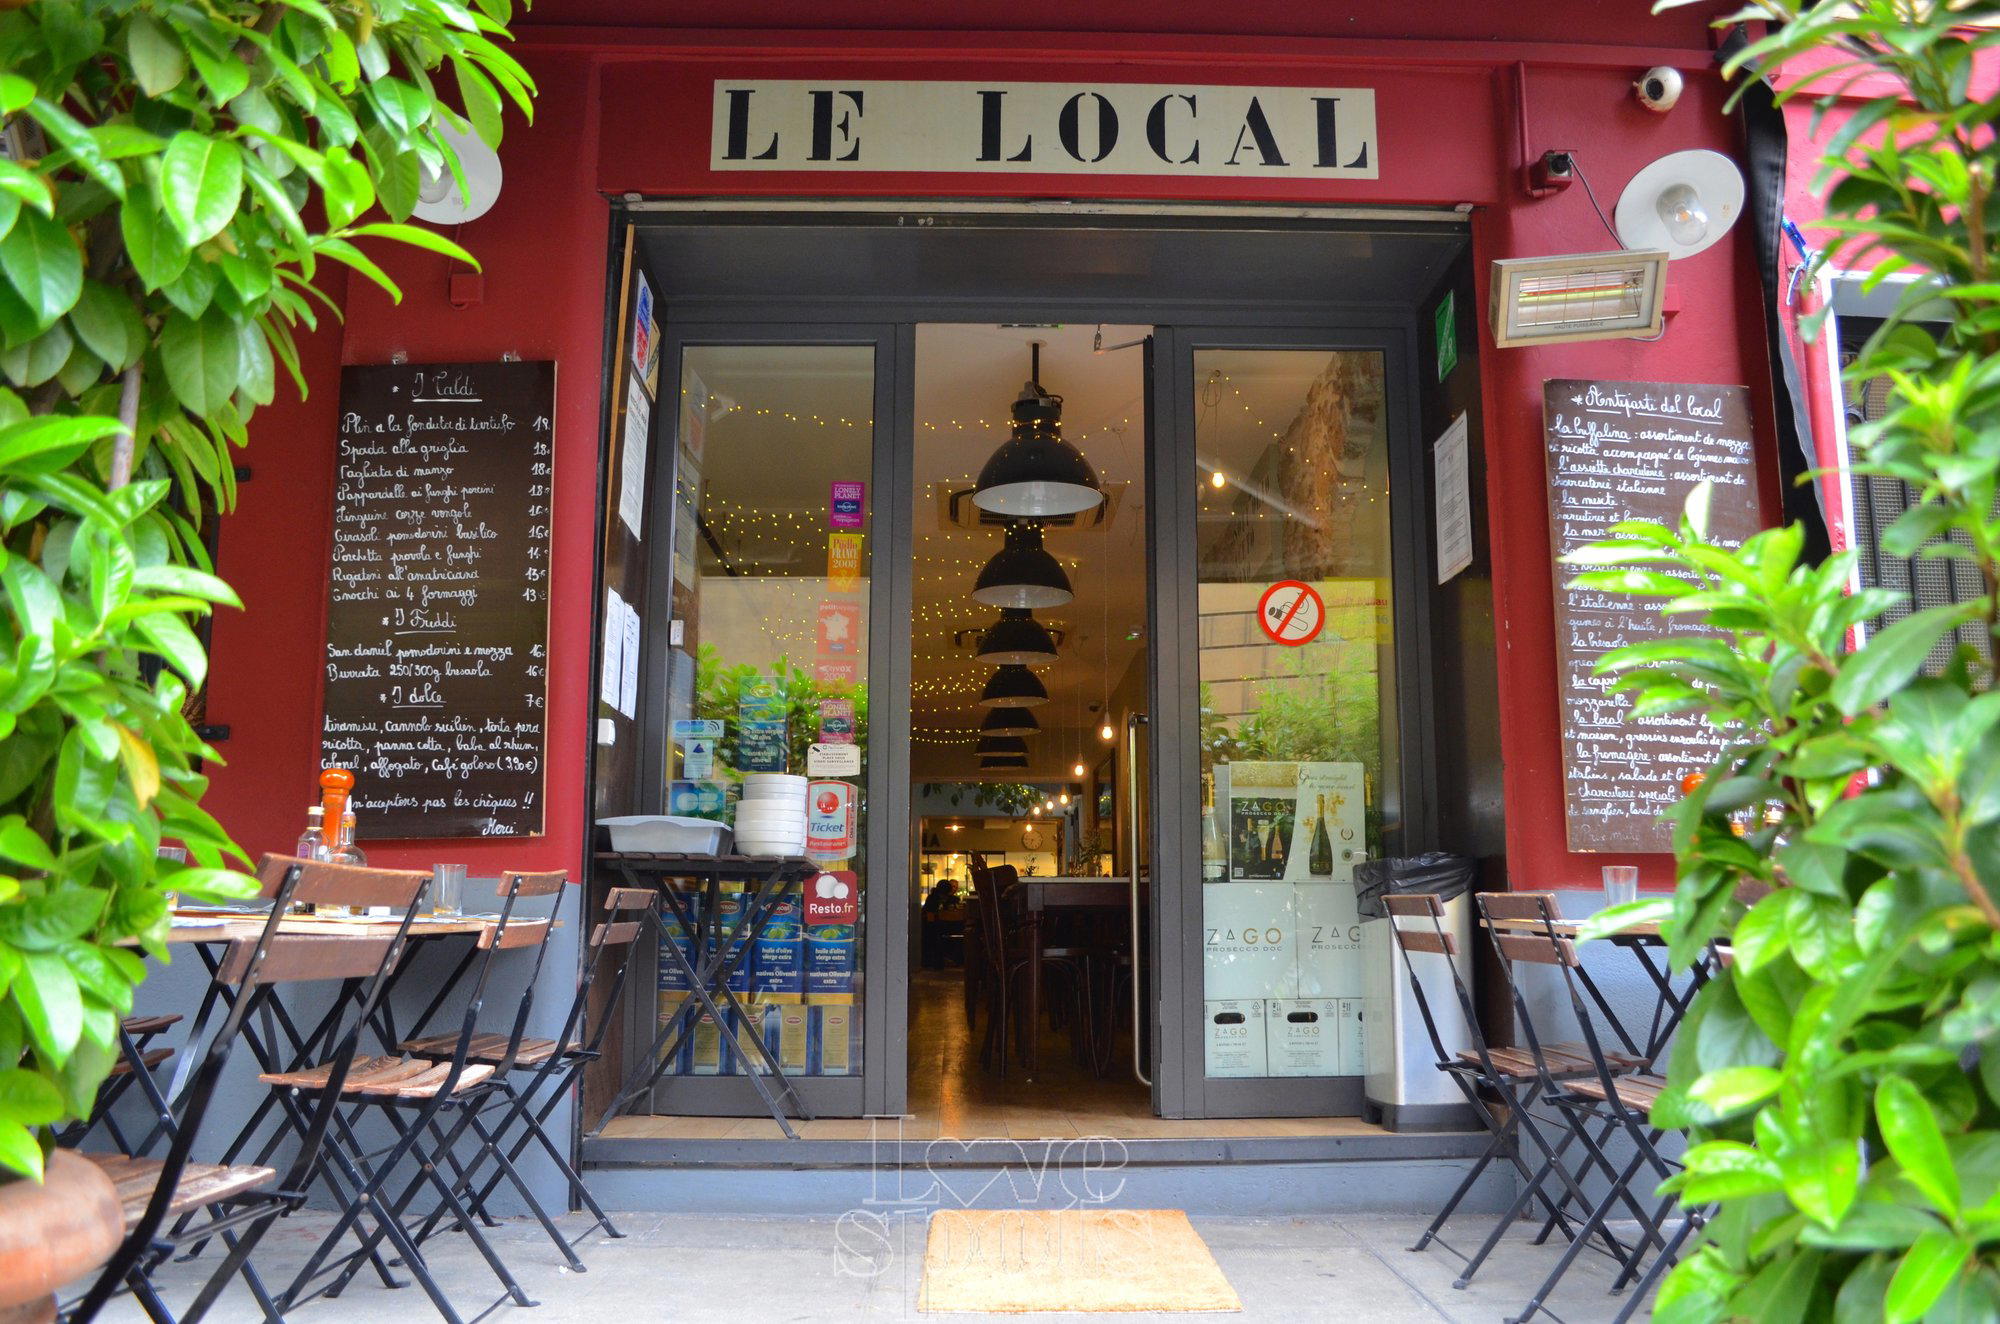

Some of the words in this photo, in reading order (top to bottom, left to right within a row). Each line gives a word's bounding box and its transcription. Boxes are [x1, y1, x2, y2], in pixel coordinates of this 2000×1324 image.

[721, 88, 865, 163] LE
[976, 89, 1368, 171] LOCAL
[1585, 385, 1657, 417] Antipasti
[1660, 395, 1682, 414] del
[375, 423, 386, 433] a
[388, 414, 403, 432] la
[406, 414, 454, 438] fonduta
[455, 416, 467, 430] di
[470, 413, 516, 436] tartufo
[1573, 416, 1631, 446] buffalina
[1640, 429, 1702, 443] assortiment
[1703, 432, 1715, 446] de
[341, 439, 387, 464] Spada
[392, 438, 418, 455] alla
[420, 437, 469, 463] griglia
[1562, 442, 1599, 456] ricotta
[1603, 447, 1671, 468] accompagné
[1673, 448, 1684, 461] de
[1687, 447, 1722, 468] légumes
[396, 465, 409, 477] di
[413, 466, 455, 481] manzo
[1558, 456, 1611, 474] l'assiette
[1612, 463, 1665, 479] charcuterie
[1733, 472, 1746, 486] de
[336, 482, 406, 507] Pappardelle
[411, 486, 422, 498] ai
[424, 483, 459, 504] funghi
[460, 481, 496, 500] porcini
[1552, 475, 1611, 490] charcuterie
[1616, 480, 1666, 496] italienne
[1562, 489, 1578, 505] la
[1582, 491, 1618, 506] mixte
[336, 505, 388, 530] Linguine
[395, 510, 426, 526] cozze
[431, 502, 472, 526] vongole
[1608, 512, 1620, 523] et
[386, 523, 448, 547] pomodorini
[456, 522, 498, 539] basilico
[1564, 523, 1579, 537] la
[1581, 528, 1606, 537] mer
[332, 543, 383, 562] Porchetta
[390, 543, 433, 567] provola
[435, 551, 442, 560] e
[446, 544, 482, 566] funghi
[332, 566, 381, 588] Rigatoni
[333, 586, 379, 602] Gnocchi
[386, 586, 400, 599] ai
[406, 586, 414, 600] 4
[421, 584, 478, 607] formaggi
[1569, 593, 1634, 611] l'italienne
[410, 608, 457, 628] Freddi
[1604, 618, 1615, 628] à
[1668, 615, 1712, 634] fromage
[1571, 633, 1587, 647] la
[327, 643, 352, 657] San
[395, 641, 462, 664] pomodorini
[464, 648, 473, 656] e
[474, 646, 514, 661] mozza
[326, 663, 381, 682] Burrata
[445, 660, 493, 677] bresaola
[1572, 675, 1587, 687] la
[1692, 678, 1703, 689] de
[409, 682, 444, 703] dolce
[525, 694, 544, 708] 7€
[1566, 694, 1632, 712] mozzarella
[484, 717, 512, 733] torta
[514, 719, 540, 738] pera
[1593, 710, 1625, 726] local
[1638, 713, 1696, 726] assortiment
[374, 740, 415, 756] panna
[456, 734, 486, 751] baba
[489, 735, 502, 750] al
[1626, 731, 1668, 749] gressins
[1670, 731, 1708, 744] enroulés
[1710, 735, 1720, 745] de
[1576, 742, 1592, 758] la
[1594, 744, 1650, 767] fromagère
[1658, 753, 1711, 763] assortiment
[461, 760, 497, 780] goloso
[1618, 768, 1658, 782] salade
[1660, 771, 1674, 781] et
[1578, 781, 1635, 799] charcuterie
[422, 797, 446, 813] pas
[454, 789, 470, 807] les
[473, 793, 517, 815] chèques
[1241, 801, 1285, 812] ZAGO
[1630, 801, 1651, 816] lard
[1653, 804, 1665, 816] de
[811, 822, 844, 833] Ticket
[810, 902, 854, 915] Resto.fr
[1207, 928, 1282, 945] ZAGO
[1215, 1028, 1247, 1036] ZAGO
[1288, 1027, 1320, 1035] ZAGO
